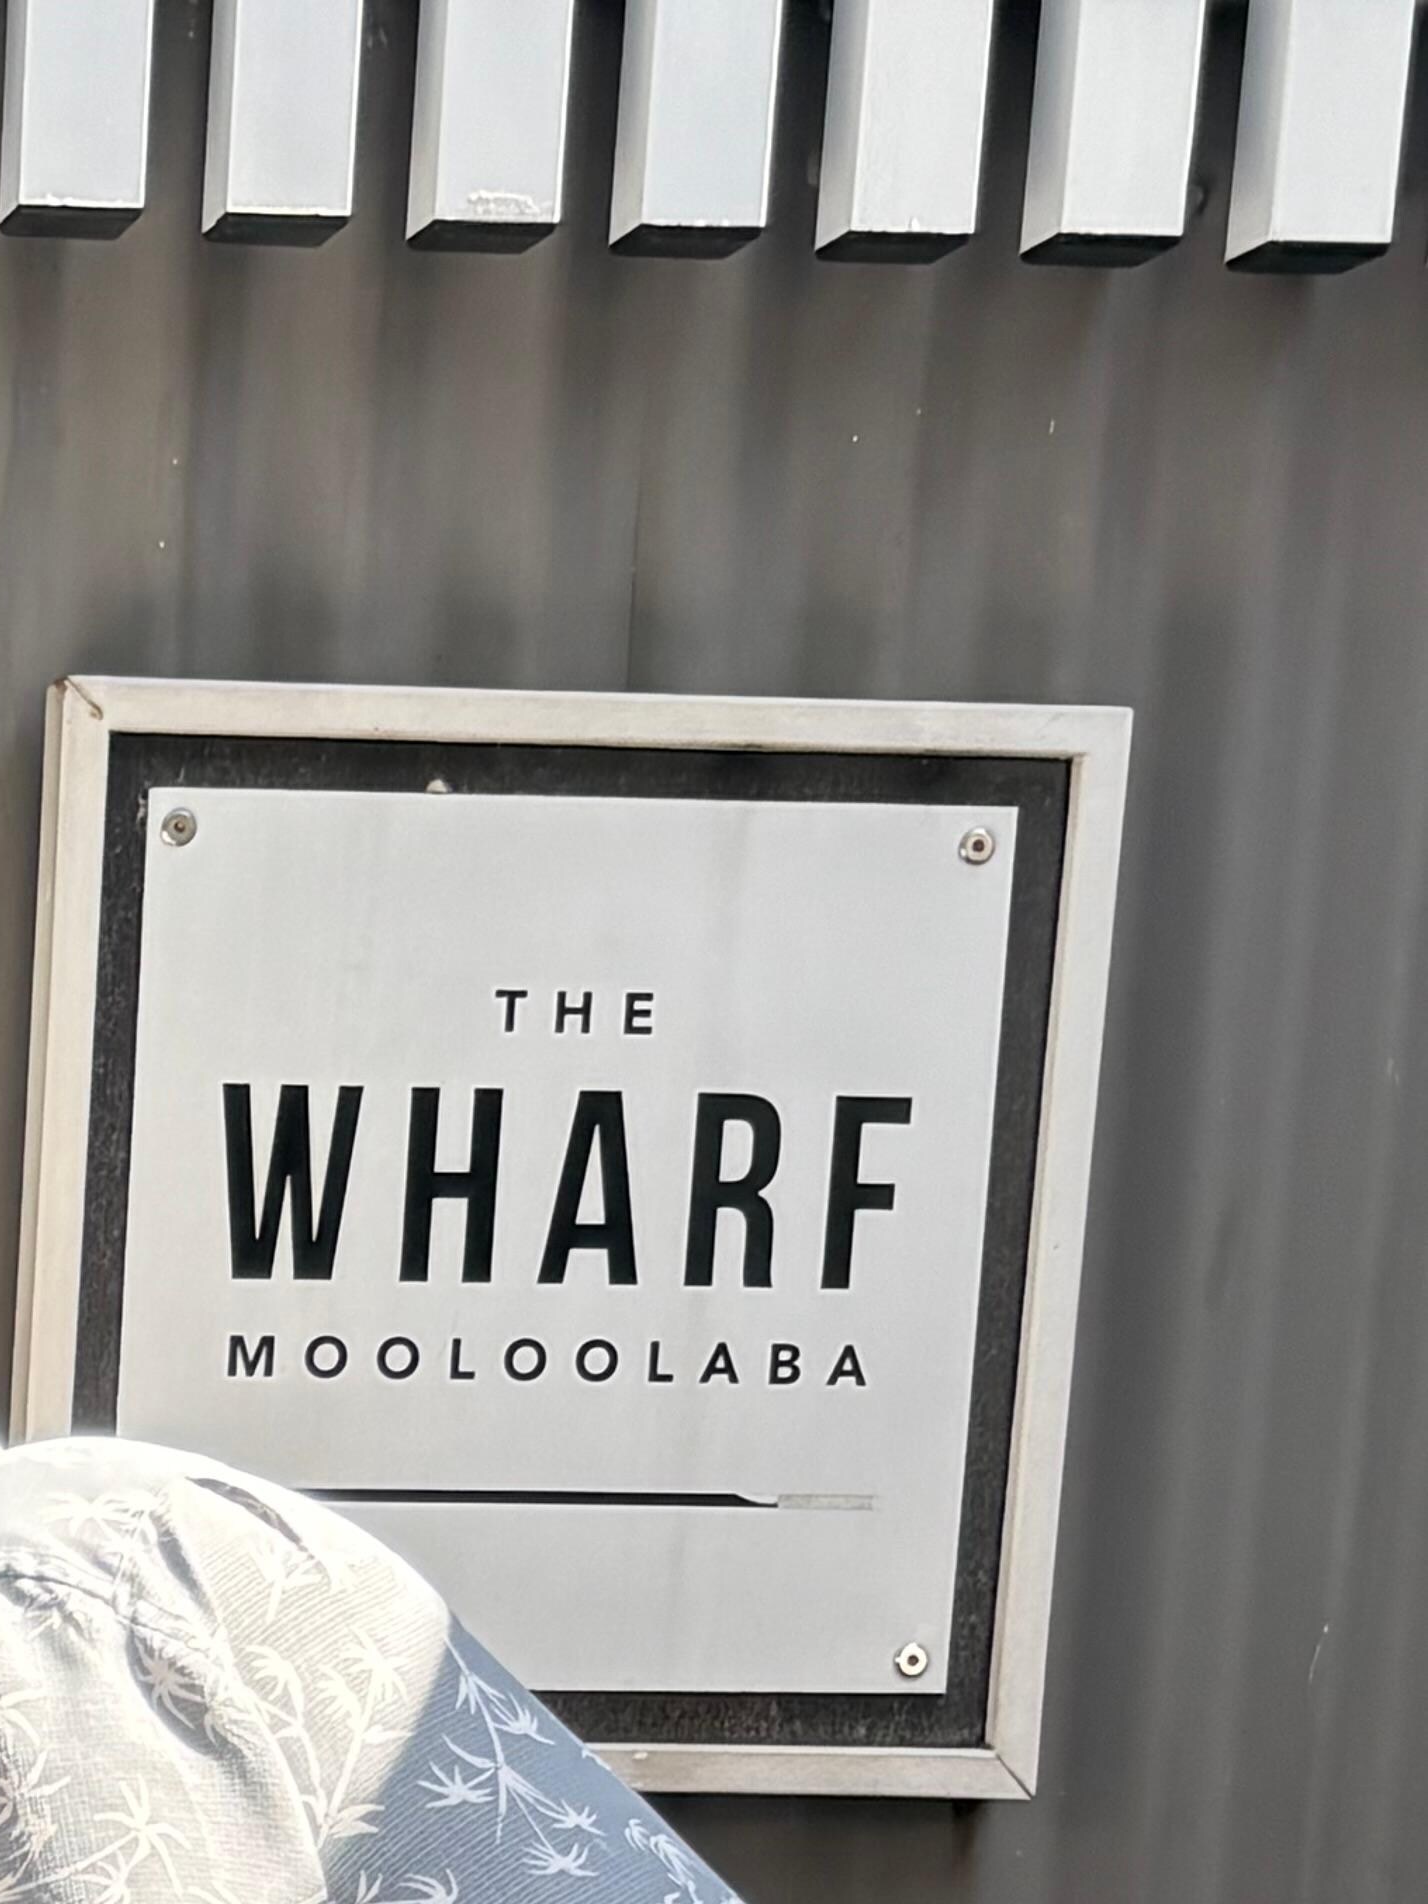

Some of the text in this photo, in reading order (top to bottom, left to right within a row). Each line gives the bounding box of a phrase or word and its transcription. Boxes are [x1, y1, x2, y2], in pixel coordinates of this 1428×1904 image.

[495, 989, 655, 1036] THE
[222, 1083, 913, 1290] WHARF
[226, 1335, 867, 1387] MOOLOOLABA
